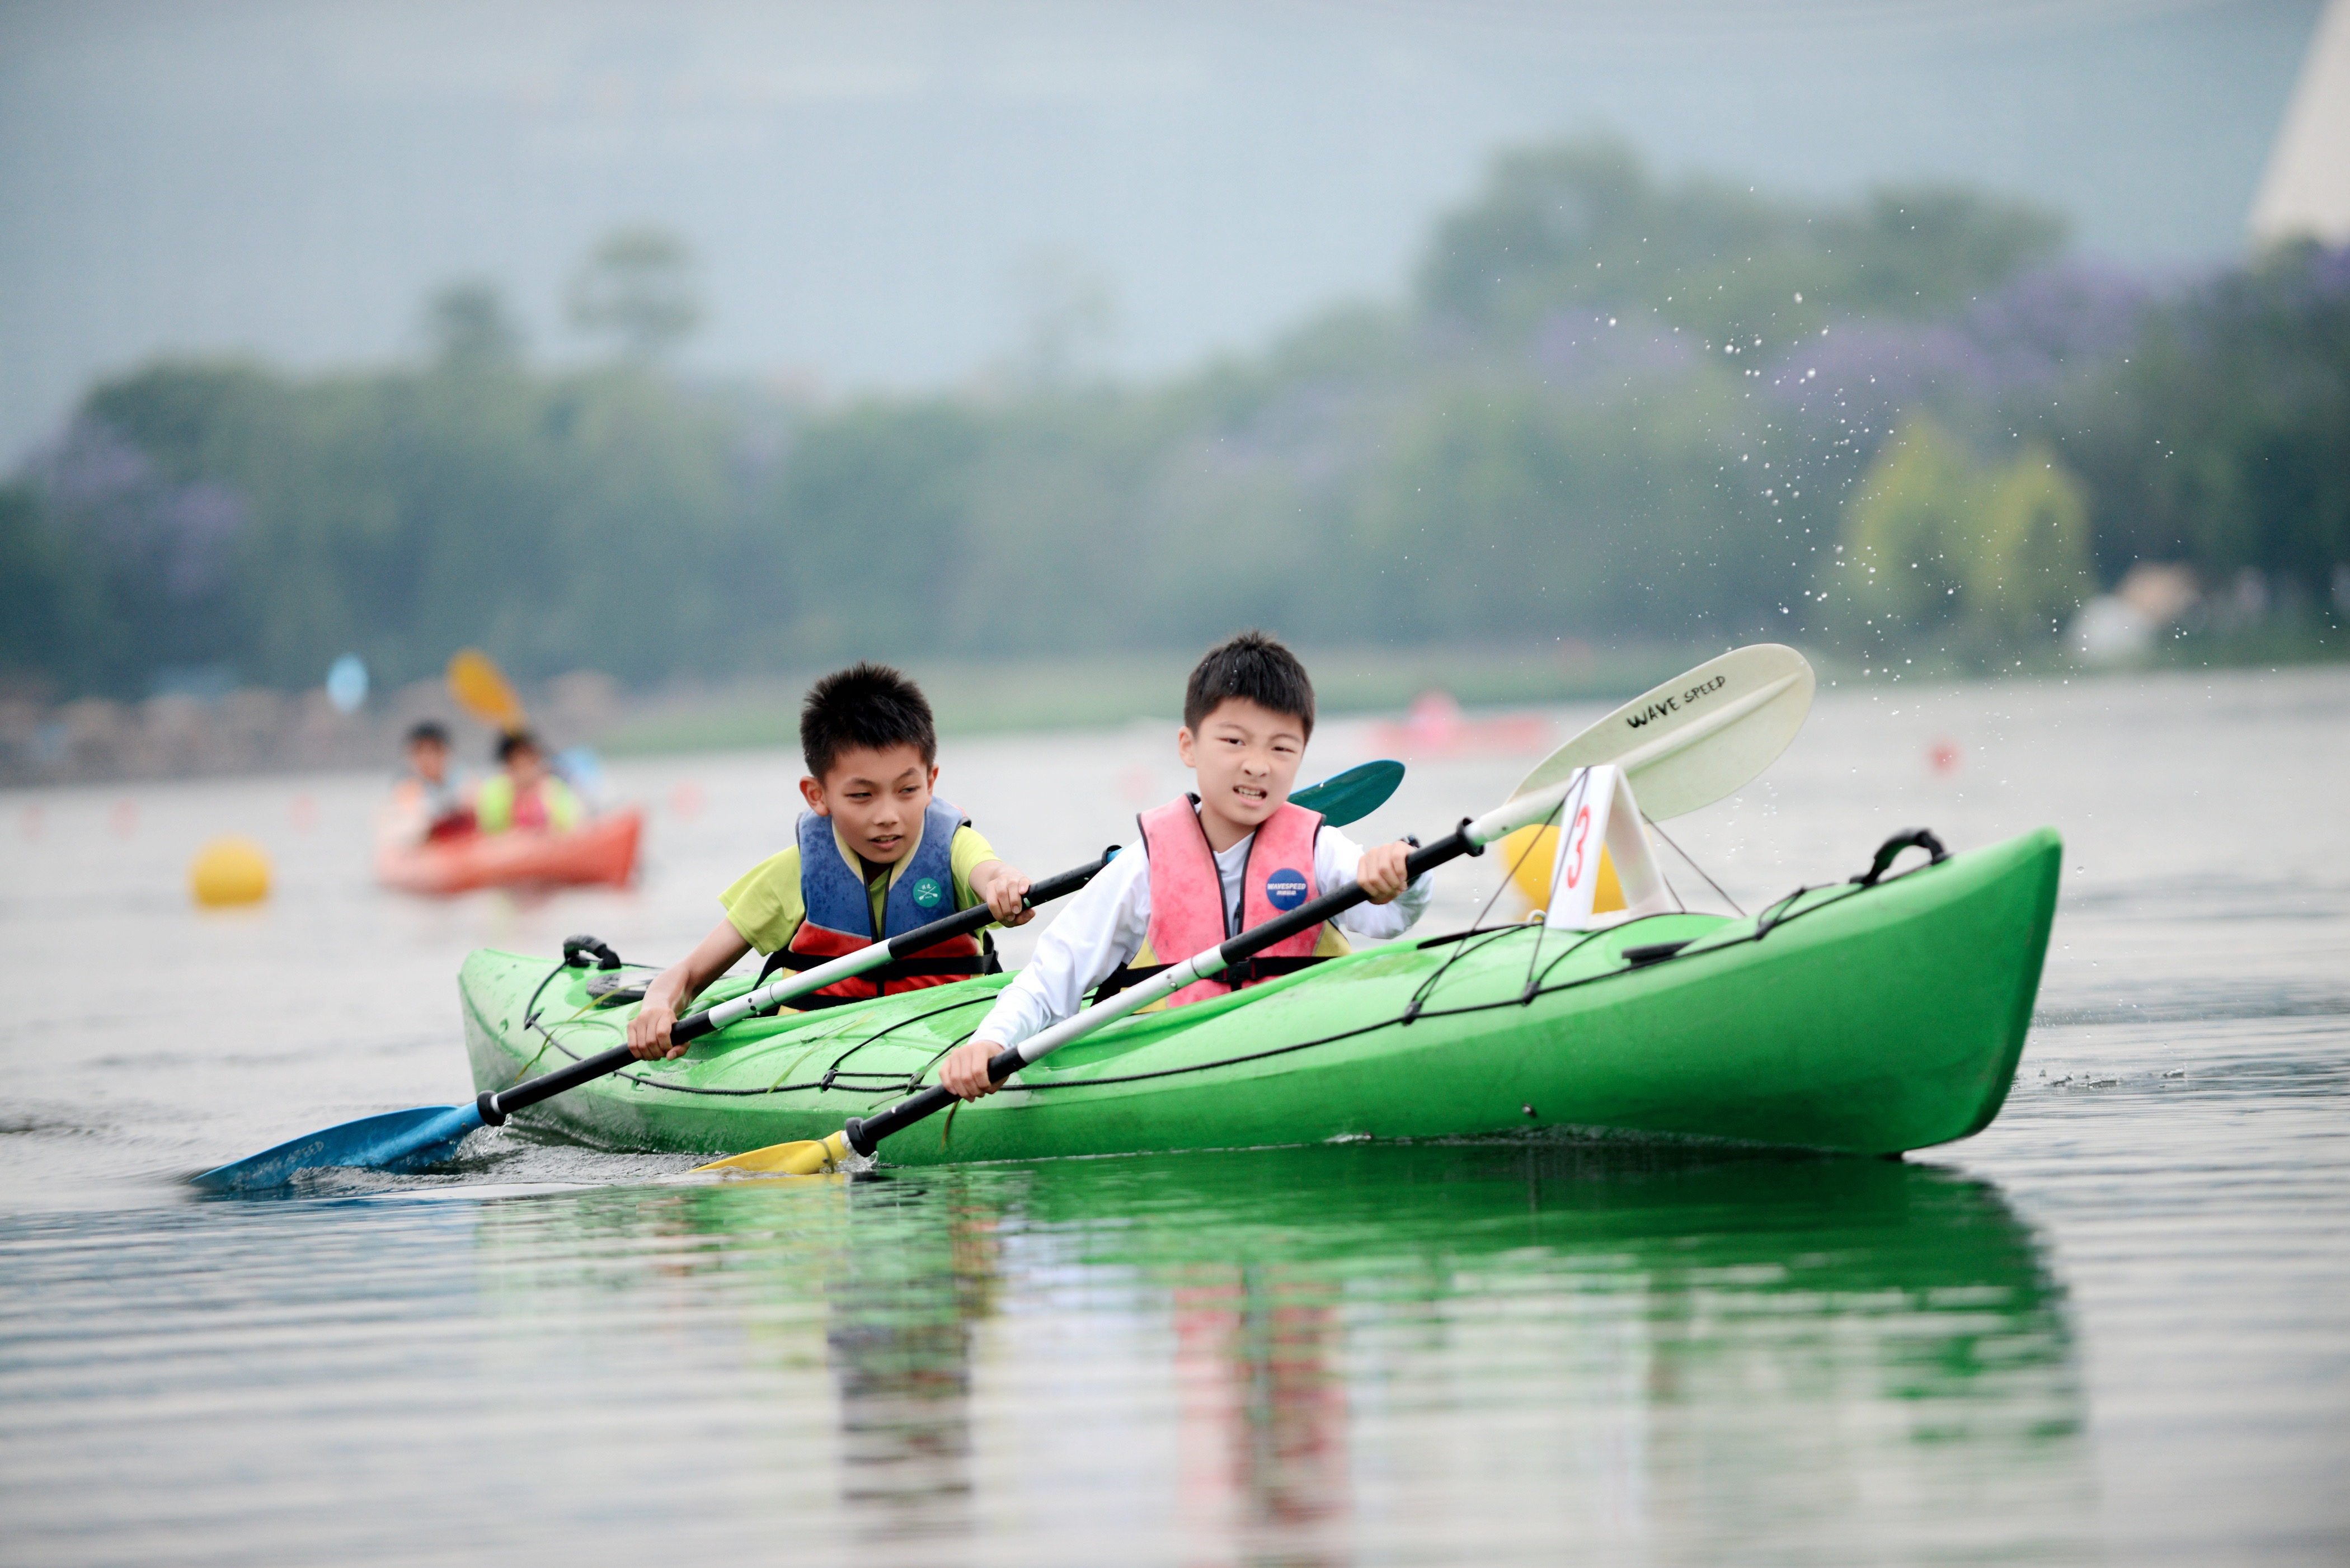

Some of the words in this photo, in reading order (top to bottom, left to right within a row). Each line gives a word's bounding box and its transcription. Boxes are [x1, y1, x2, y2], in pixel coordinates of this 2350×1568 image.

[1627, 696, 1681, 728] WAVE
[1684, 676, 1726, 703] SPEED
[1567, 804, 1591, 888] 3
